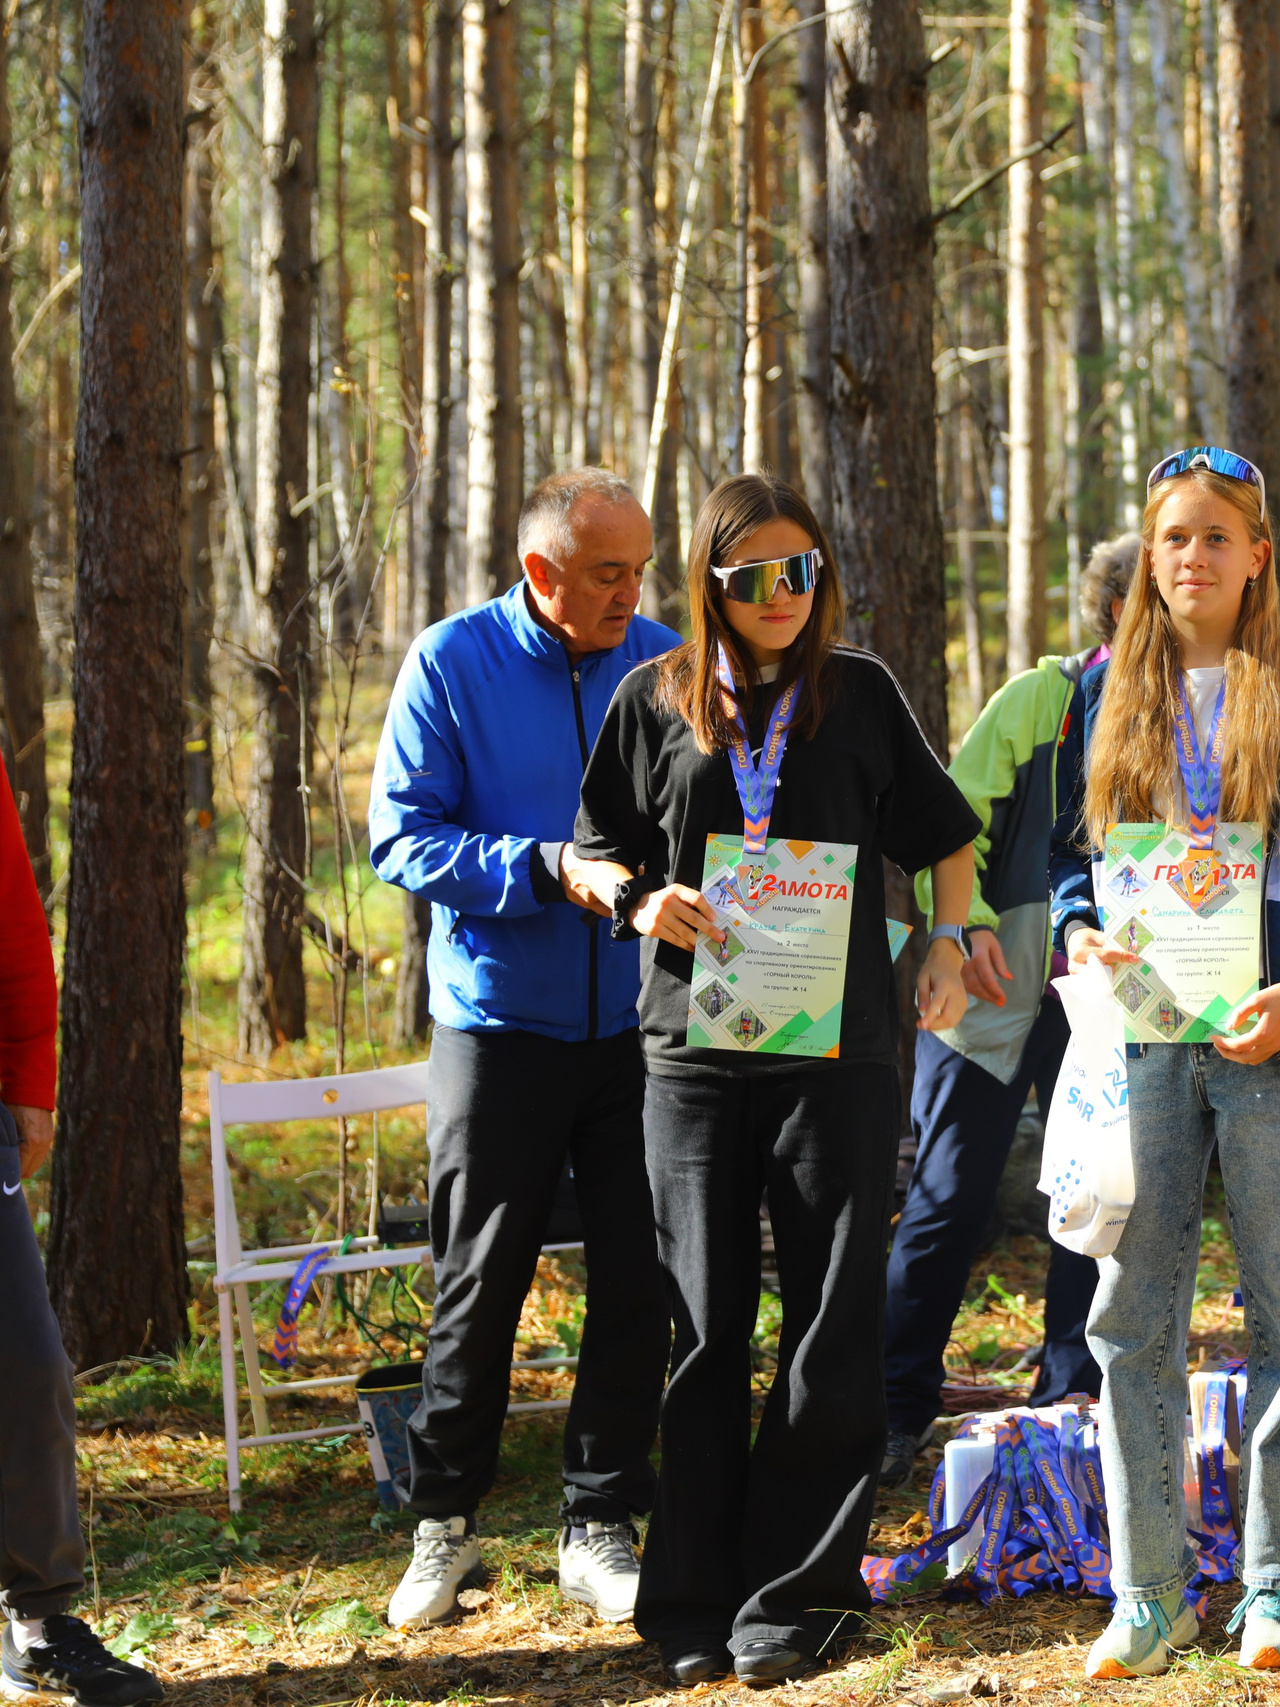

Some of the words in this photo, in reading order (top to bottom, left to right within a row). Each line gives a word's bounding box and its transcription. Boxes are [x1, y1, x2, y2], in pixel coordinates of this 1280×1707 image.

[761, 873, 778, 892] 2
[1212, 869, 1221, 887] 1
[1201, 884, 1227, 904] КОРОЛЬ
[772, 905, 821, 915] НАГРАЖДАЕТСЯ
[760, 950, 800, 958] традиционных
[800, 953, 842, 961] соревнованиях
[1084, 1462, 1103, 1505] ГОРНЫЙ
[1039, 1460, 1063, 1496] ГОРНЫЙ
[1060, 1497, 1078, 1536] КОРОЛЬ
[992, 1491, 1007, 1530] ГОРНЫЙ
